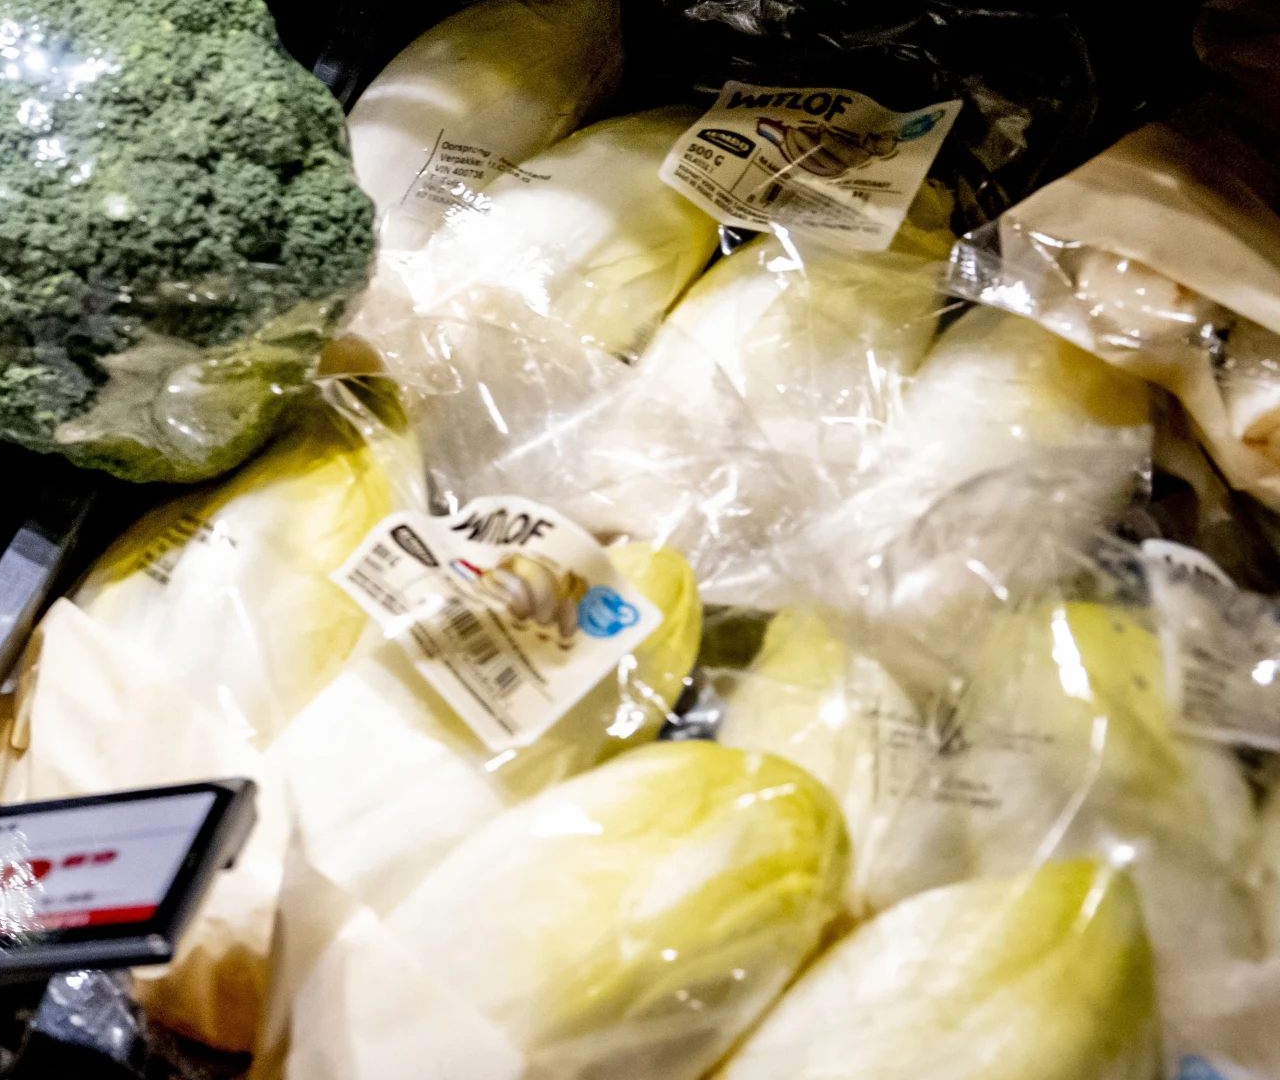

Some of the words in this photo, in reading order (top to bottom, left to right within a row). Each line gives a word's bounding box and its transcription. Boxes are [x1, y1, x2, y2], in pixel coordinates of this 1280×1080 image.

[726, 90, 853, 121] WITLOF
[686, 143, 713, 160] 500
[713, 155, 725, 168] G
